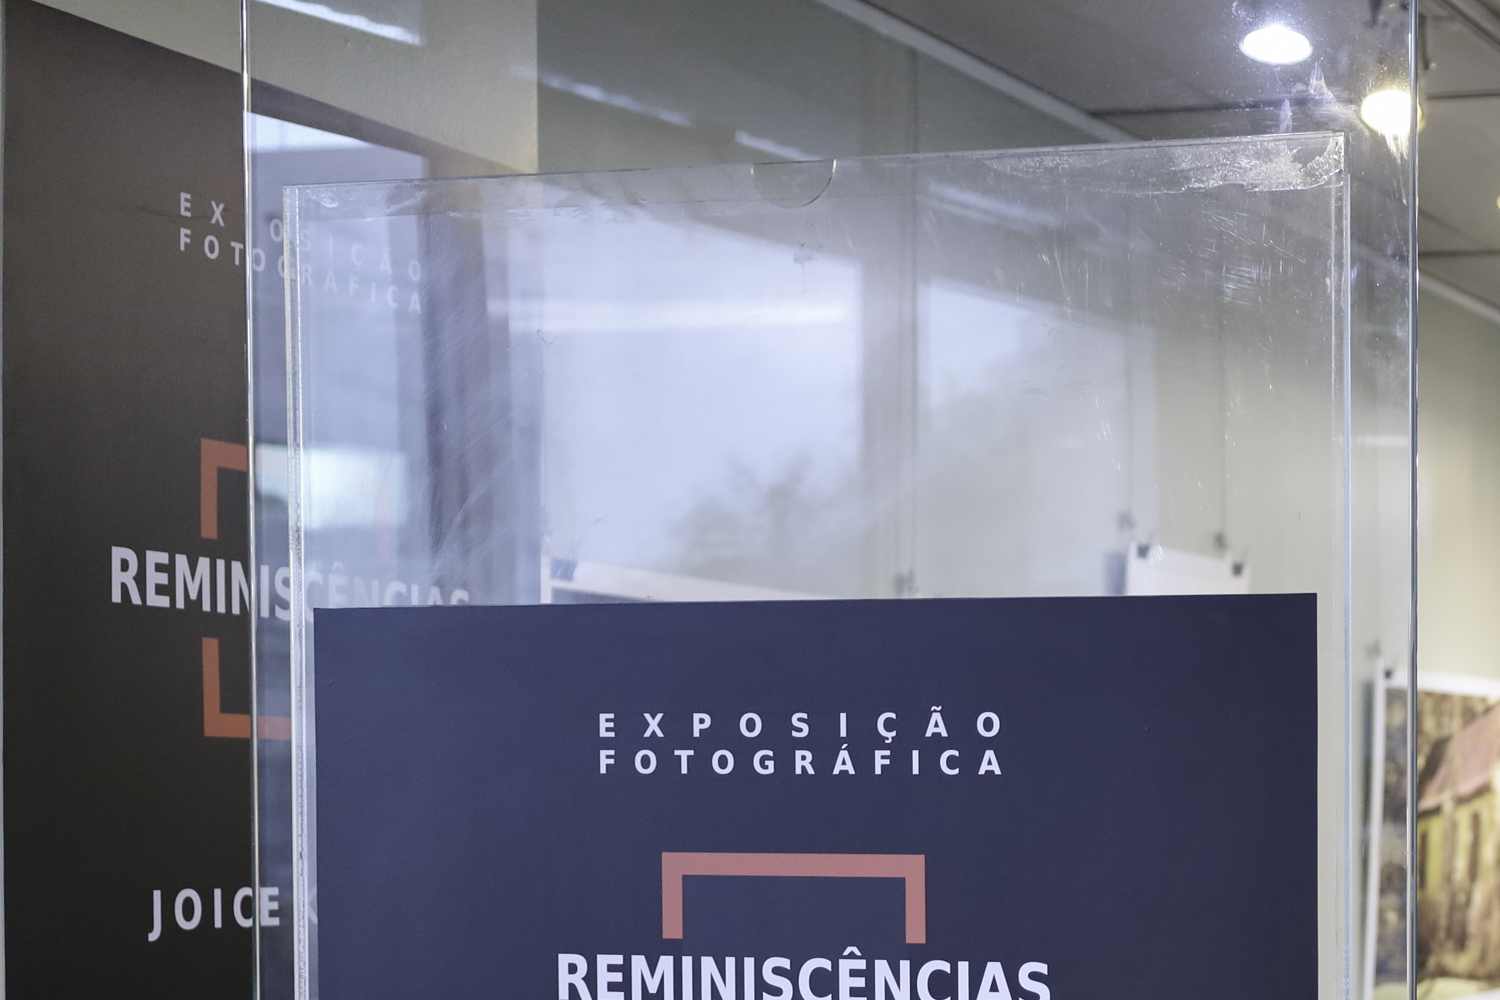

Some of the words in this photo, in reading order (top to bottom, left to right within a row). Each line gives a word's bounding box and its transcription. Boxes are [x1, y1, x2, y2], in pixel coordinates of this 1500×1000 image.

[599, 706, 1000, 743] EXPOSIÇÃO
[600, 744, 1001, 775] FOTOGRÁFICA
[148, 887, 280, 942] JOICE
